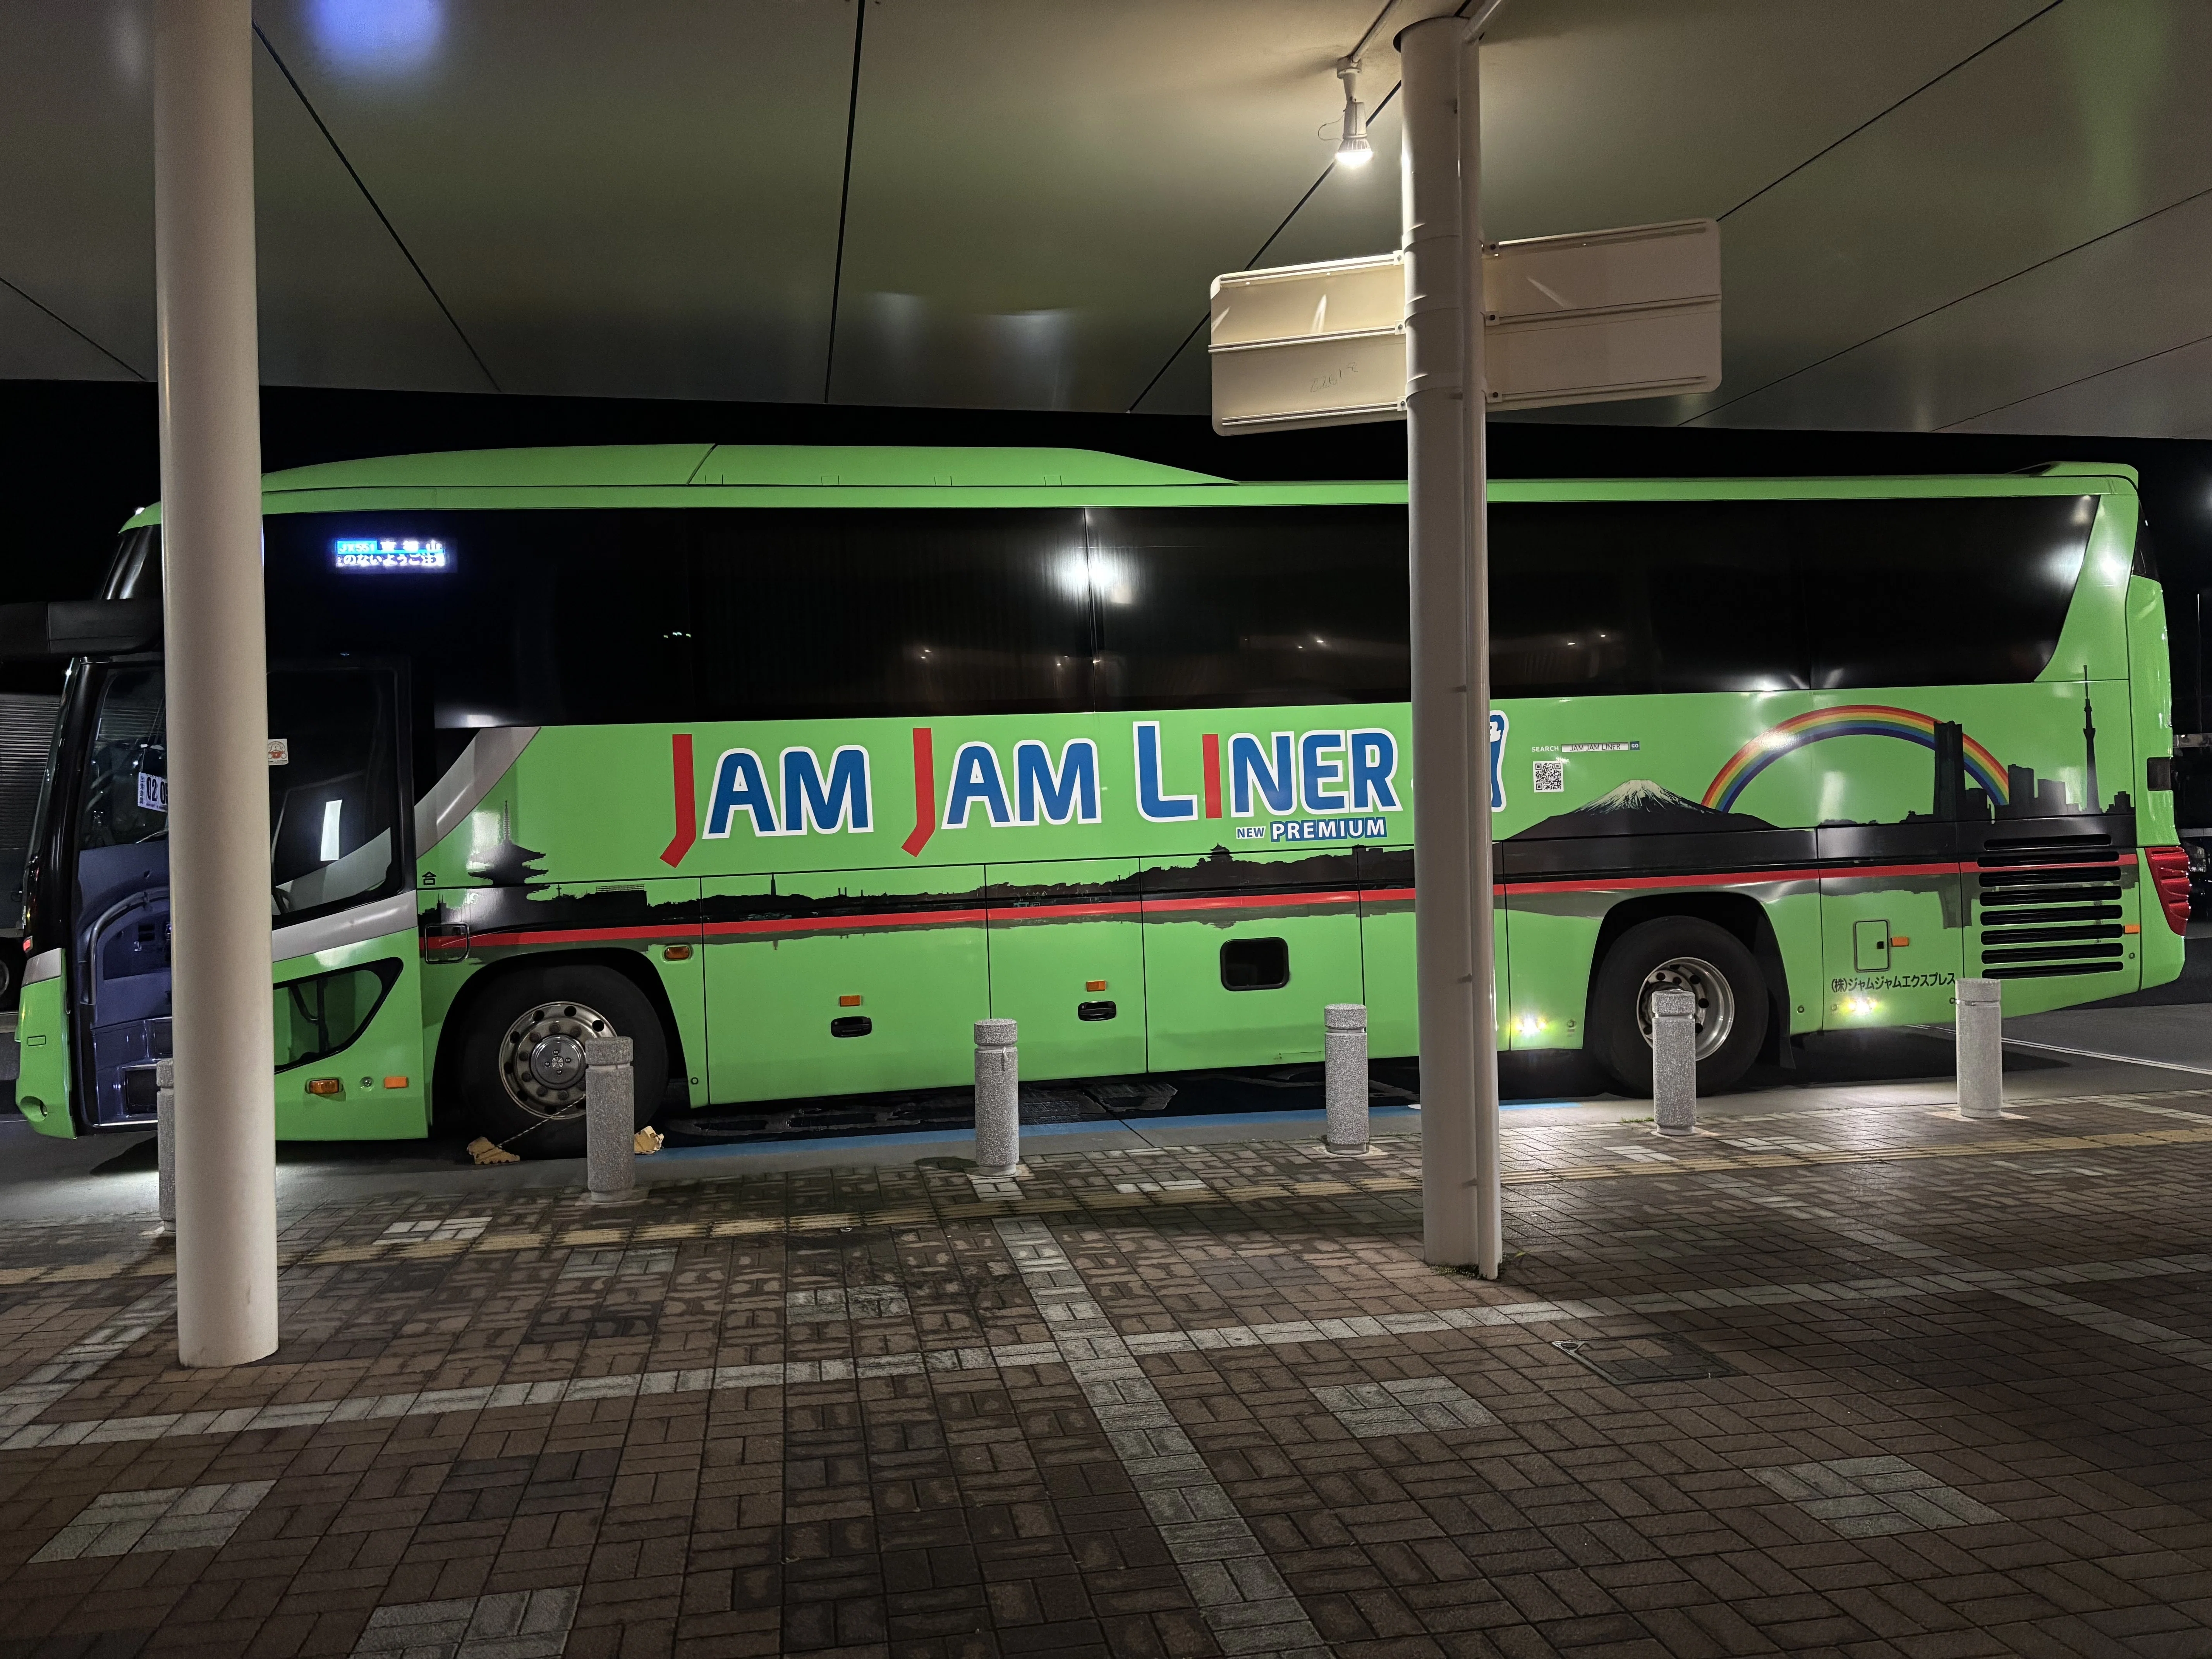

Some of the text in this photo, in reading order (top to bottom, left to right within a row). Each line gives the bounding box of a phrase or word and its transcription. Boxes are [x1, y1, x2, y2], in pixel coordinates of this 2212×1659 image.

[660, 721, 1403, 868] JAM JAM LINER
[1237, 819, 1385, 840] NEW PREMIUM
